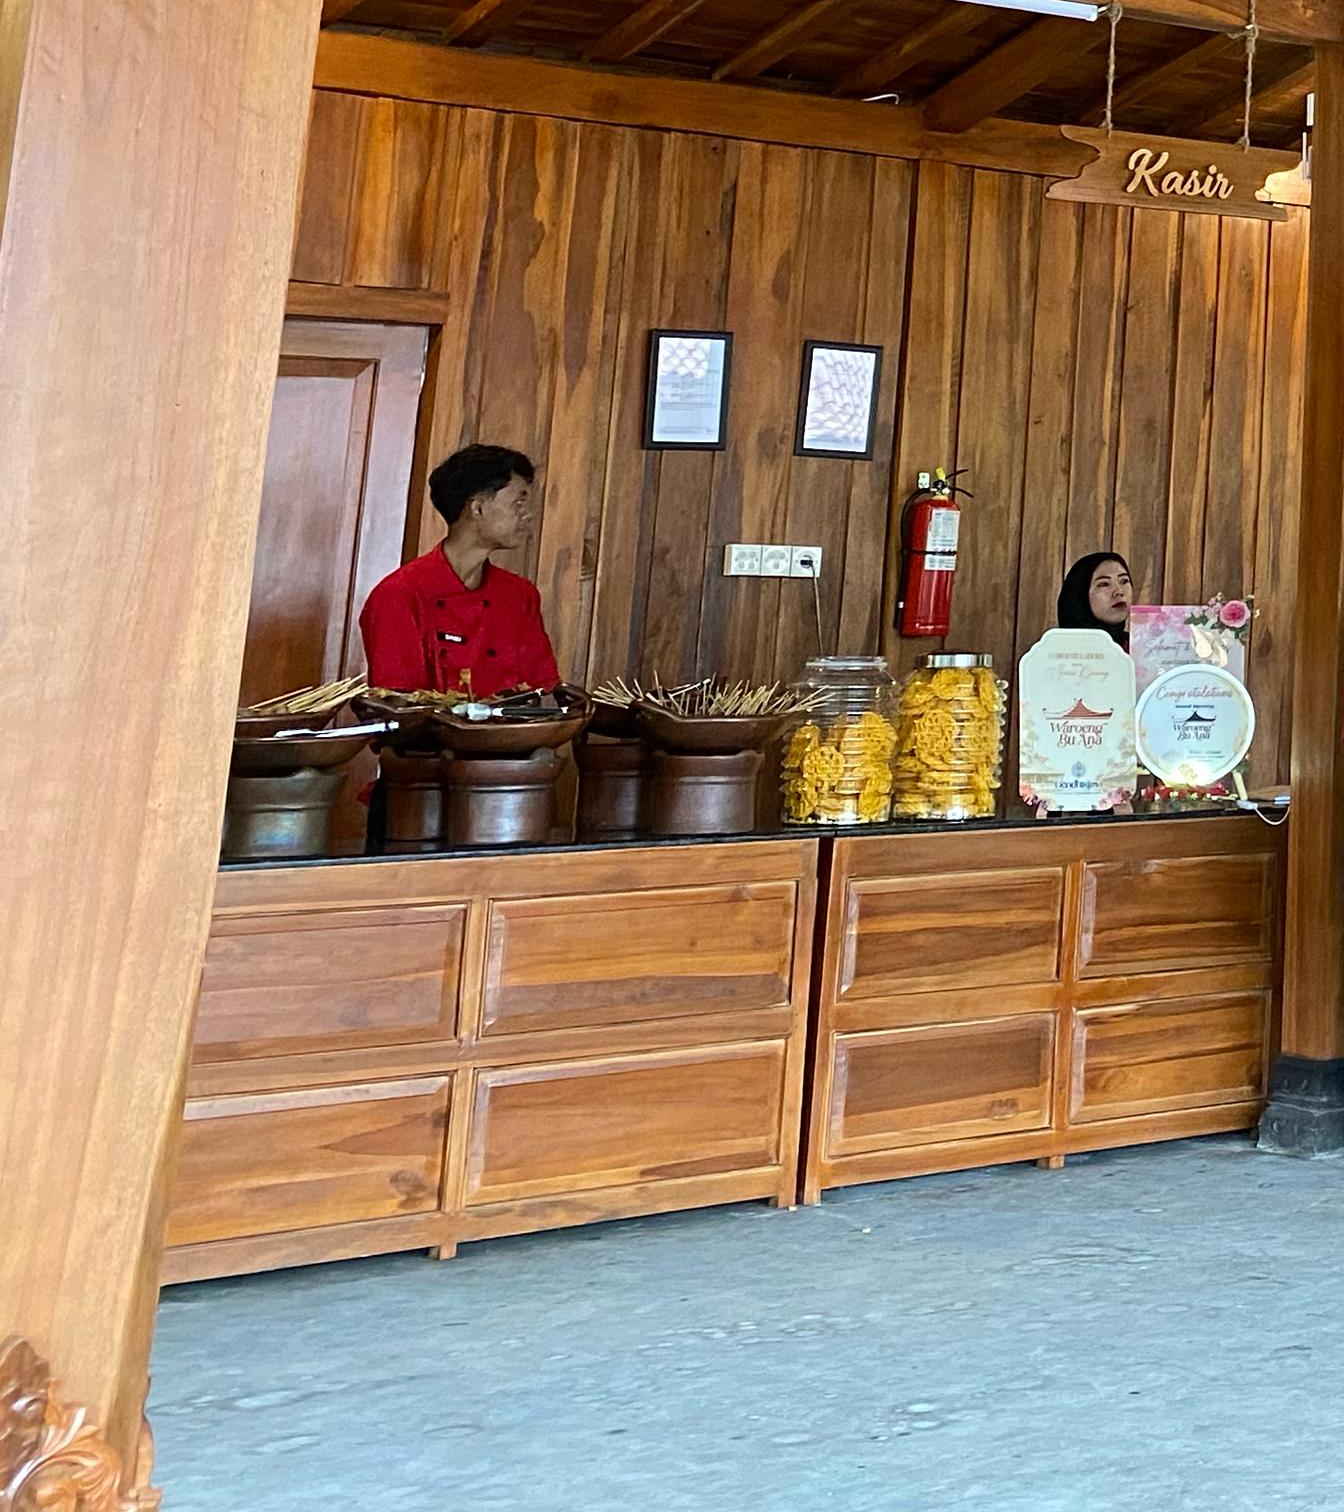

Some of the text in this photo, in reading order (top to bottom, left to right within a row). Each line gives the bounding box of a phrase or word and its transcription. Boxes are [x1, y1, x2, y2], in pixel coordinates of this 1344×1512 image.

[1126, 148, 1234, 200] Kasir
[1050, 721, 1108, 735] Waroeng
[1057, 733, 1102, 748] Bu Ana
